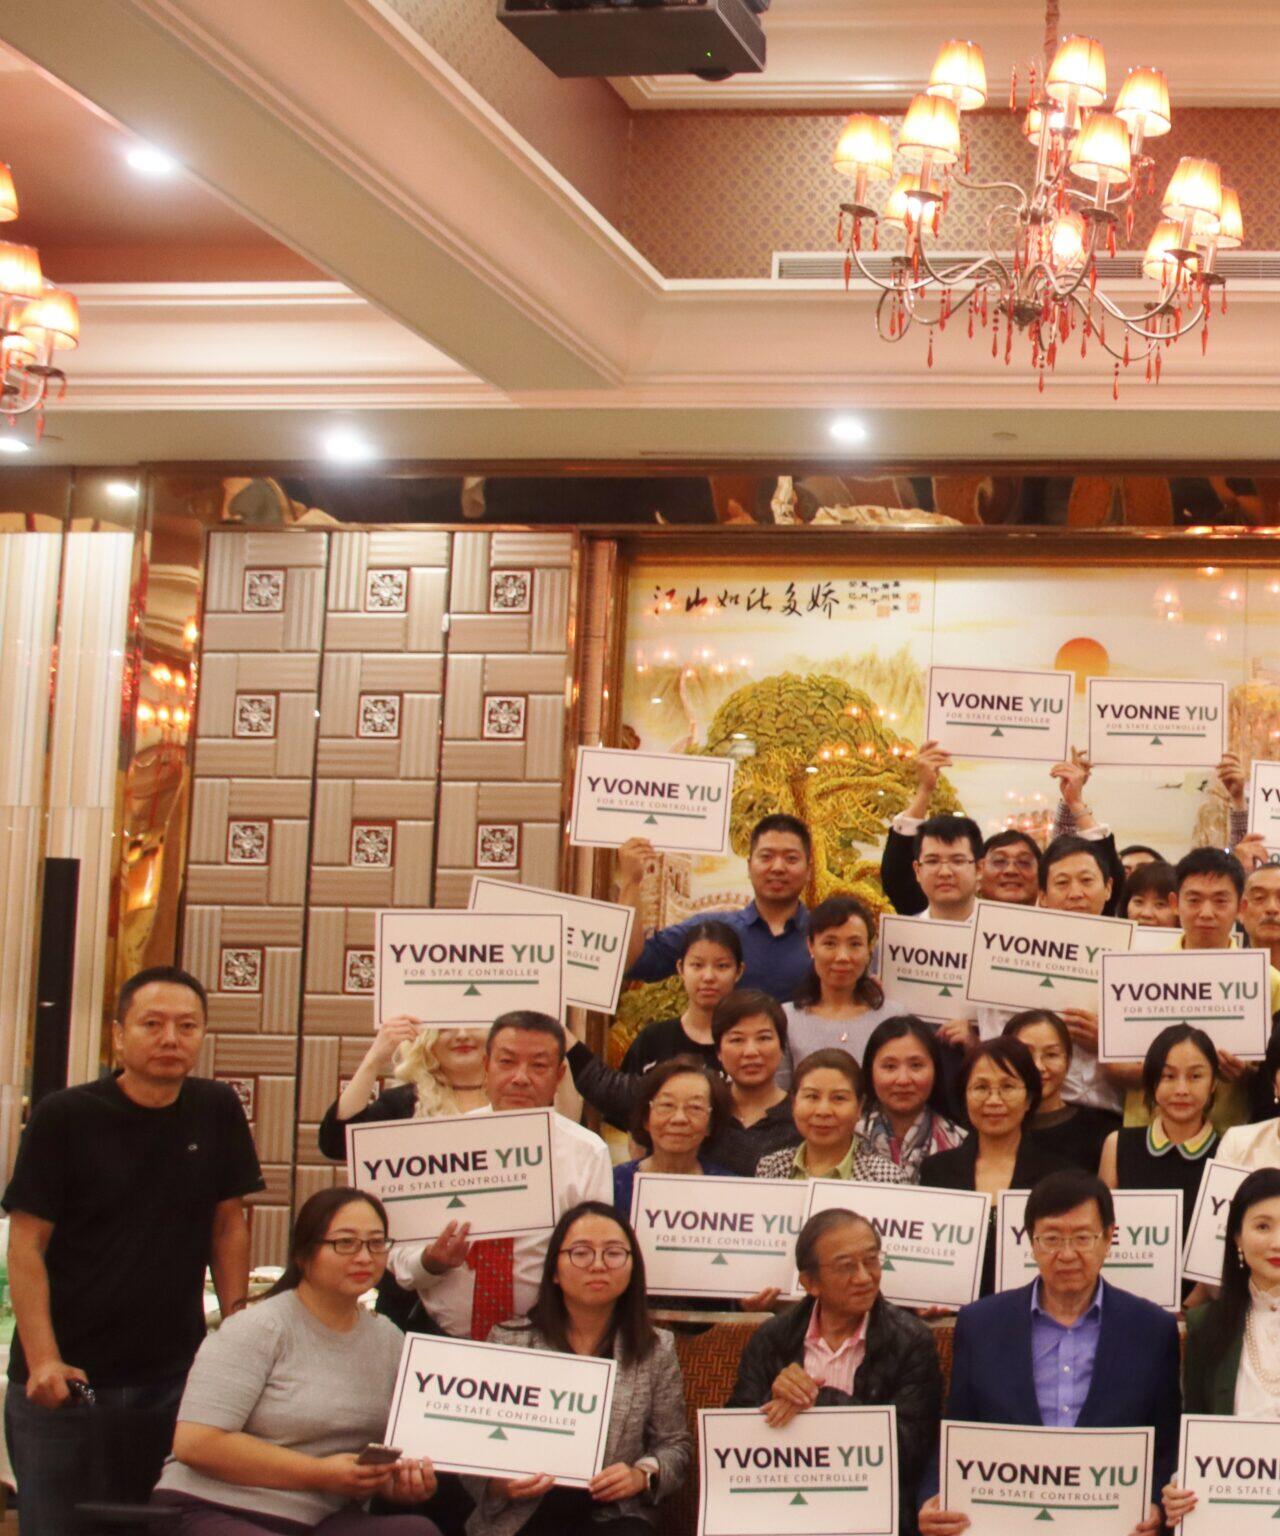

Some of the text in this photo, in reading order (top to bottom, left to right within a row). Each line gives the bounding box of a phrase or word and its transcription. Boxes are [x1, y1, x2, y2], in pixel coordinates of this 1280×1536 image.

[936, 692, 1064, 714] YVONNE YIU
[1096, 704, 1218, 722] YVONNE YIU
[587, 777, 722, 803] YVONNE YIU
[581, 930, 618, 953] YIU
[982, 932, 1079, 961] YVONNE
[389, 944, 555, 964] YVONNE YIU
[403, 968, 540, 977] FOR STATE CONTROLLER
[1110, 982, 1259, 1002] YVONNE YIU
[1124, 1004, 1245, 1014] FOR STATE CONTROLLER
[363, 1146, 544, 1180] YVONNE YIU
[380, 1173, 528, 1194] FOR STATE CONTROLLER
[644, 1209, 803, 1235] YVONNE YIU
[655, 1234, 787, 1249] FOR STATE CONTROLLER
[931, 1223, 975, 1246] YIU
[1126, 1226, 1170, 1246] YIU
[886, 1243, 956, 1257] CONTROLLER
[415, 1371, 598, 1414] YVONNE YIU
[425, 1400, 577, 1428] FOR STATE CONTROLLER
[714, 1446, 885, 1469] YVONNE YIU
[729, 1473, 869, 1484] FOR STATE CONTROLLER
[955, 1460, 1139, 1487] YVONNE YIU
[971, 1486, 1120, 1501] FOR STATE CONTROLLER
[1208, 1484, 1234, 1495] FOR
[1238, 1486, 1275, 1496] STATE
